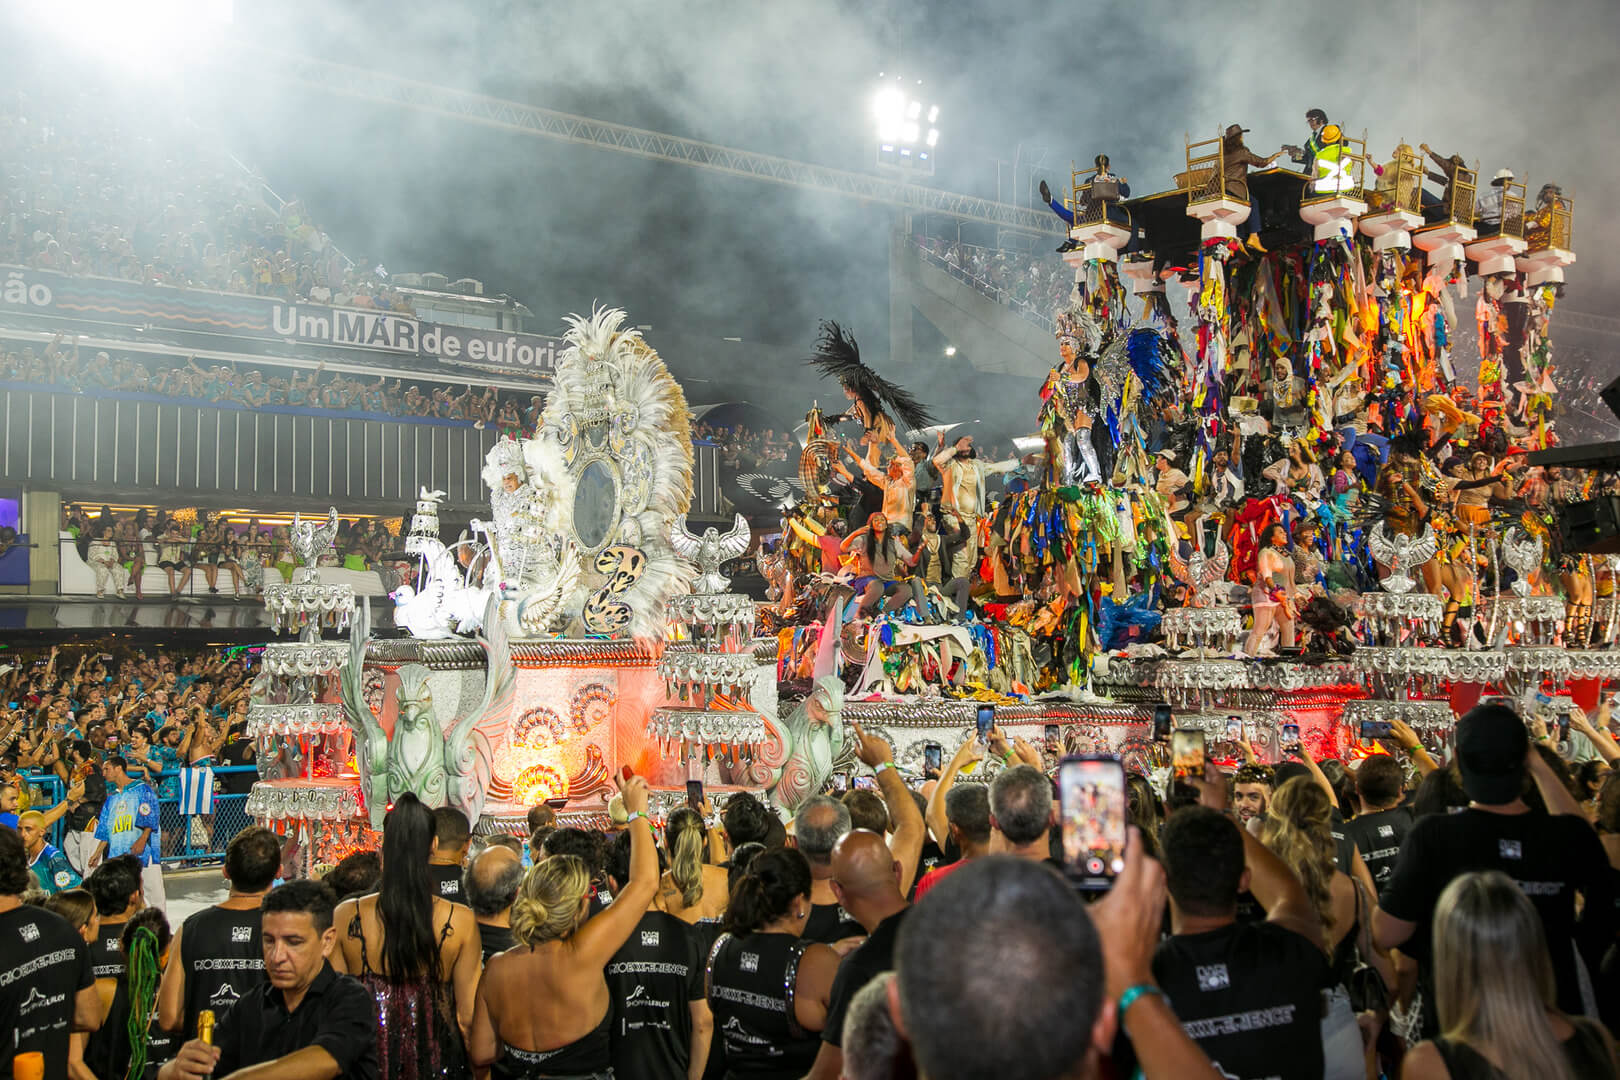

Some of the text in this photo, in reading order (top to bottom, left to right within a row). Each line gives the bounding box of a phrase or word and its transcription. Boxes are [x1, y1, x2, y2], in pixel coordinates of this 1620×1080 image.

[0, 271, 52, 306] ão
[273, 305, 330, 340] Um
[422, 327, 461, 358] de
